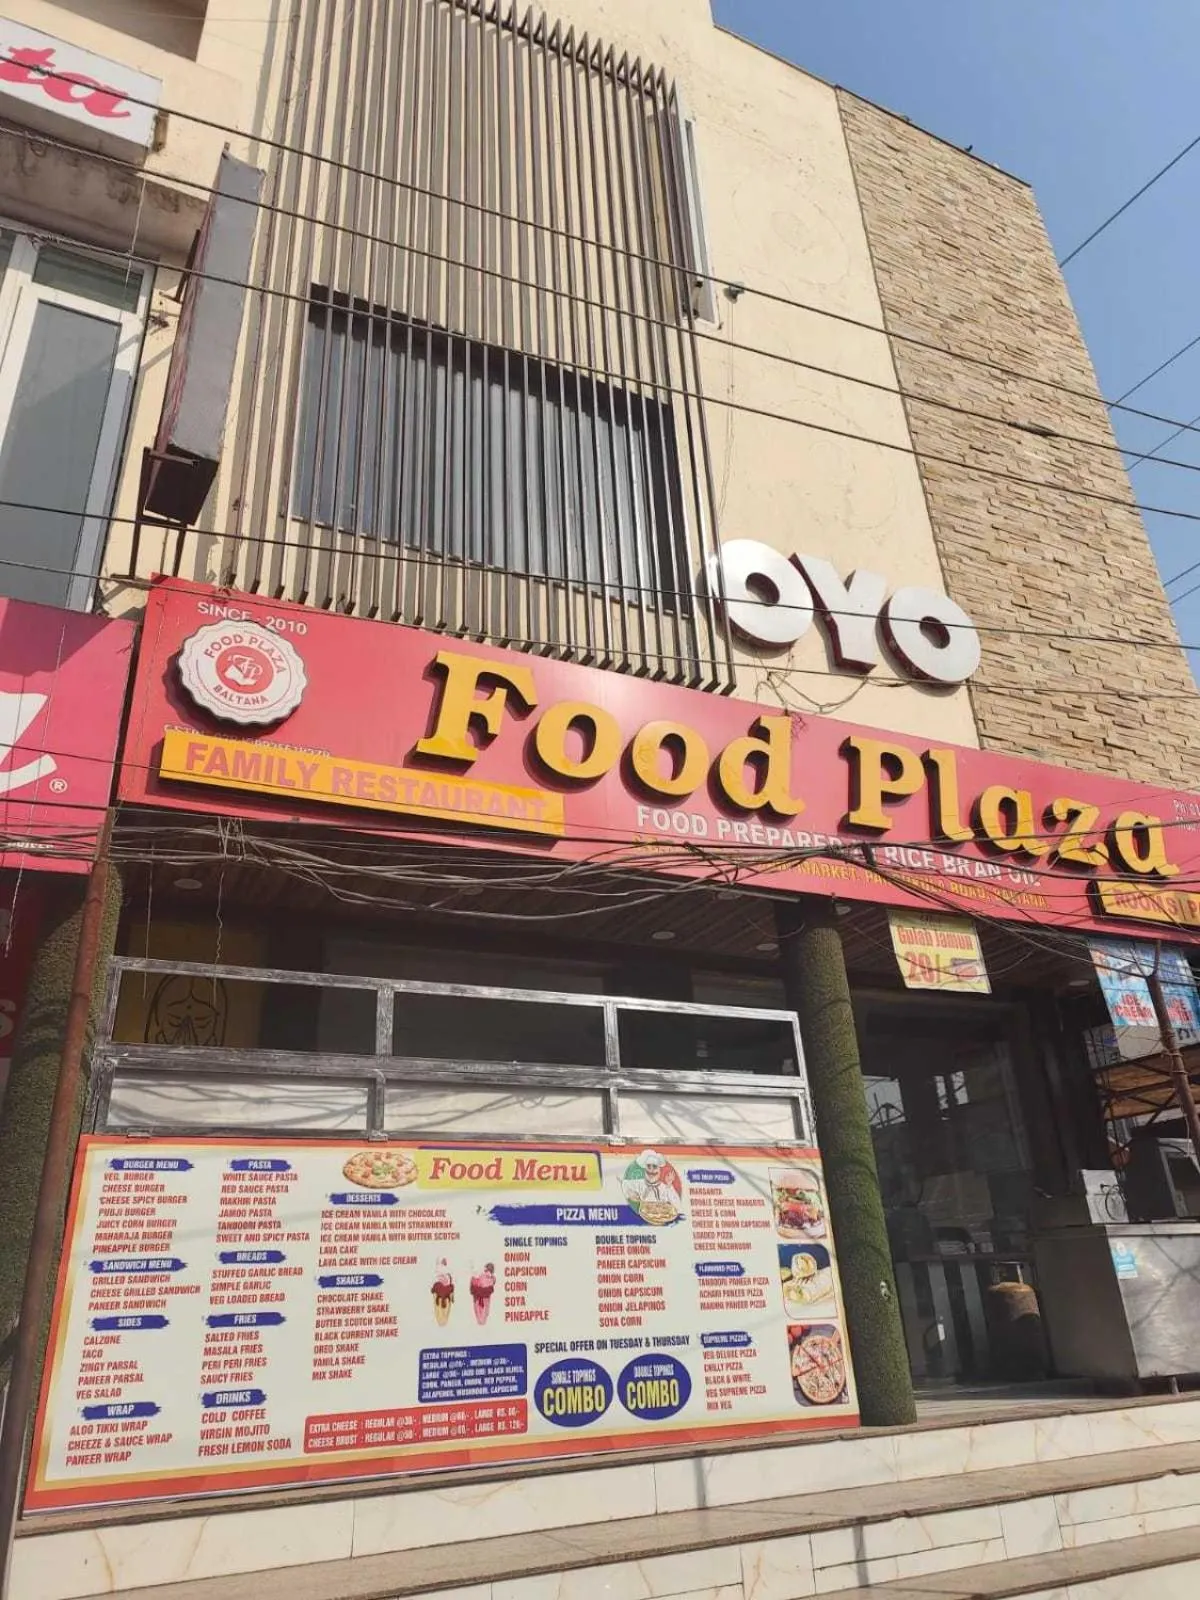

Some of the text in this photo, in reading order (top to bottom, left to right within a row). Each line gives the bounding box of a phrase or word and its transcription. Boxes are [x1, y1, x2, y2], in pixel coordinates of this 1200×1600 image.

[708, 539, 981, 682] OYO
[197, 602, 250, 620] SINCE
[266, 616, 307, 635] 2010
[204, 634, 287, 673] FOOD PLAZA
[213, 685, 268, 704] BALTANA
[416, 650, 1181, 877] Food Plaza
[186, 742, 547, 821] FAMILY RESTAURANT
[637, 805, 708, 837] FOOD
[716, 819, 842, 849] PREPARED
[885, 846, 936, 868] RICE
[943, 856, 1001, 880] BRAN
[123, 1161, 178, 1169] BURGER MENU
[248, 1161, 271, 1169] PASTA
[429, 1158, 588, 1181] Food Menu
[134, 1184, 164, 1192] BURGER
[100, 1195, 187, 1204] CHEESE SPICY BURGER
[346, 1194, 381, 1202] DESSERTS
[557, 1209, 618, 1220] PIZZA MENU
[97, 1219, 177, 1228] JUICY CORN BURGER
[95, 1231, 173, 1240] MAHARAJA BURGER
[216, 1233, 310, 1243] SWEET AND SPICY PASTA
[596, 1235, 656, 1244] DOUBLE TOPINGS
[505, 1237, 567, 1247] SINGLE TOPINGS
[93, 1243, 170, 1253] PINEAPPLE BURGER
[320, 1246, 358, 1254] LAVA CAKE
[597, 1246, 651, 1255] PANEER ONION
[237, 1253, 267, 1261] BREADS
[505, 1253, 530, 1262] ONION
[103, 1260, 172, 1270] SANDWICH MENU
[597, 1259, 666, 1269] PANEER CAPSICUM
[213, 1267, 302, 1278] STUFFED GARLIC BREAD
[505, 1267, 546, 1277] CAPSICUM
[93, 1274, 170, 1285] GRILLED SANDWICH
[598, 1274, 644, 1283] ONION CORN
[90, 1285, 200, 1298] CHEESE GRILLED SANDWICH
[505, 1282, 527, 1291] CORN
[598, 1287, 662, 1298] ONION CAPSICUM
[318, 1293, 384, 1303] CHOCOLATE SHAKE
[505, 1297, 526, 1306] SOYA
[88, 1300, 166, 1310] PANEER SANDWICH
[317, 1304, 389, 1315] STRAWBERRY SHAKE
[599, 1303, 622, 1312] ONION
[505, 1311, 549, 1321] PINEAPPLE
[118, 1318, 141, 1327] SIDES
[600, 1317, 641, 1327] SOYA CORN
[84, 1336, 121, 1345] CALZONE
[535, 1335, 689, 1353] SPECIAL OFFER ON TUESDAY & THURSDAY
[83, 1350, 102, 1358] TACO
[202, 1357, 267, 1370] PERI PERI FRIES
[201, 1372, 253, 1384] SAUCY FRIES
[312, 1370, 352, 1380] MIX SHAKE
[77, 1388, 121, 1399] VEG SALAD
[216, 1392, 251, 1404] DRINKS
[626, 1379, 679, 1410] COMBO
[543, 1385, 605, 1417] COMBO
[107, 1405, 134, 1415] WRAP
[202, 1409, 266, 1424] COLD COFFEE
[70, 1421, 148, 1436] ALOO TIKKI WRAP
[200, 1424, 270, 1440] VIRGIN MOJITO
[199, 1439, 291, 1456] FRESH LEMON SODA
[66, 1452, 131, 1466] PANEER WRAP
